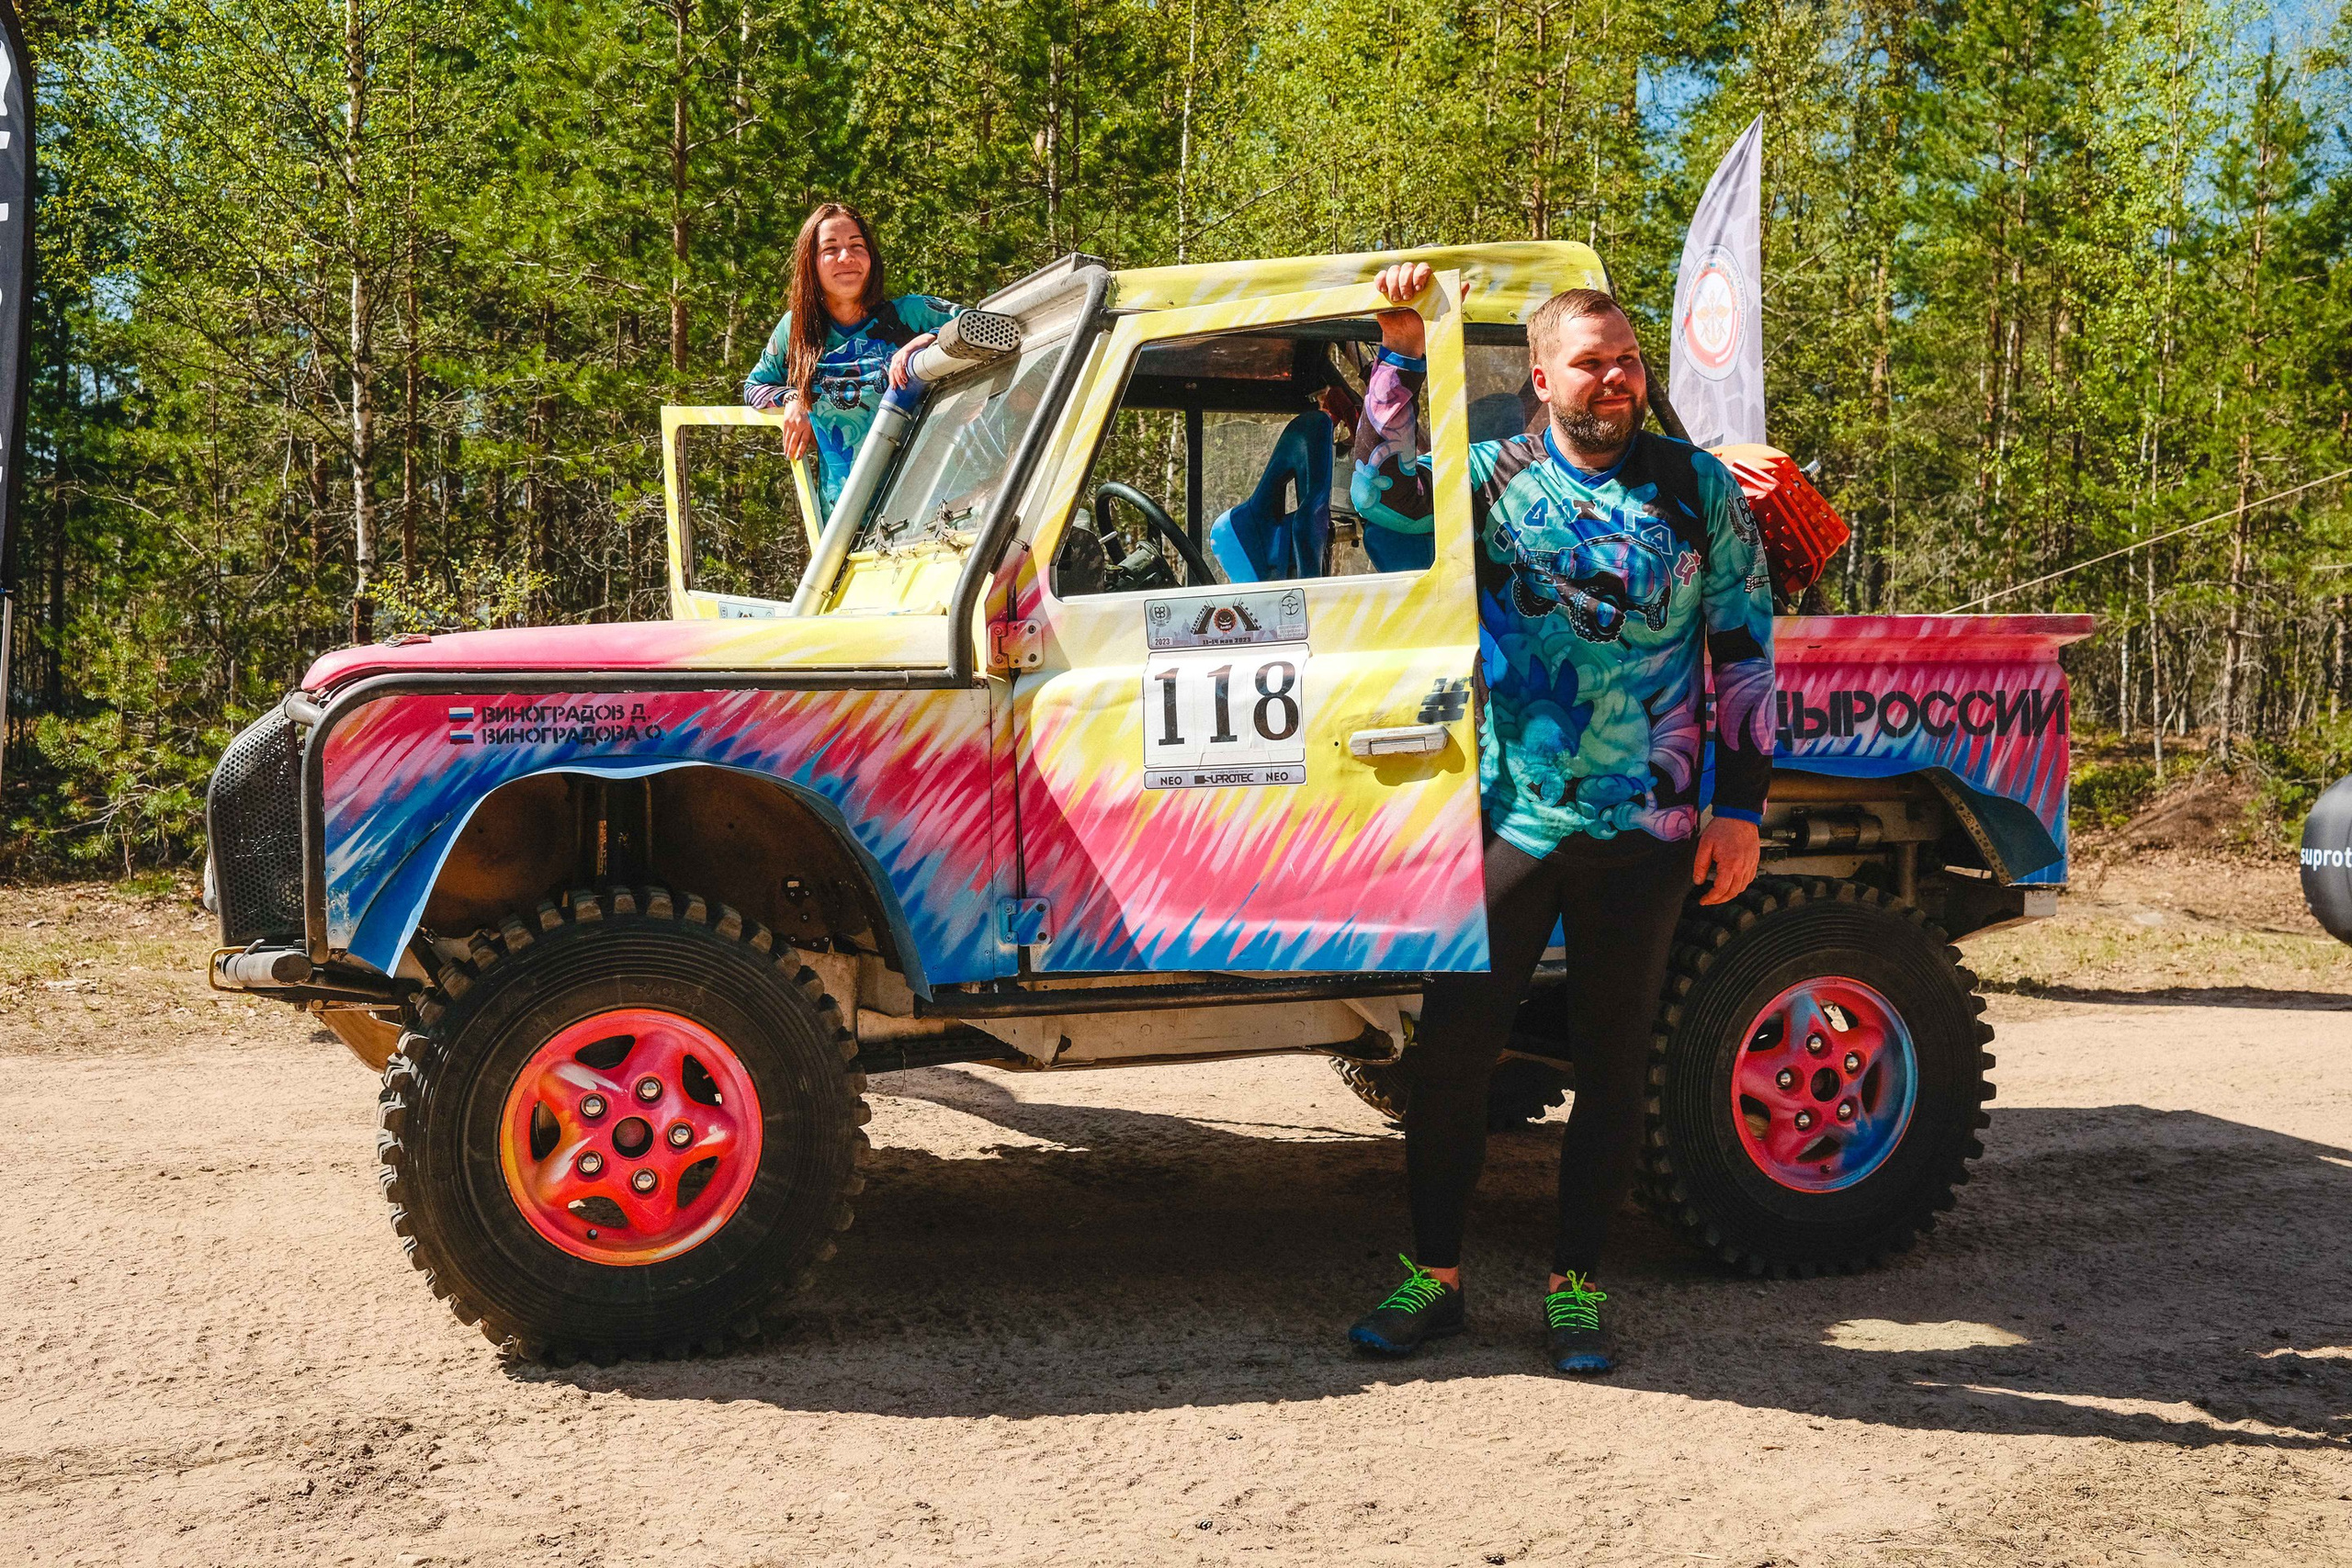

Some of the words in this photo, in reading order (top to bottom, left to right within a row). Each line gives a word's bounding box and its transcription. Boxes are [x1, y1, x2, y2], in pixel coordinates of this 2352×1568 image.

[1155, 637, 1170, 646] 2023
[1154, 660, 1299, 746] 118
[482, 705, 626, 724] ВИНОГРАДОВ
[631, 704, 651, 723] Д.
[1777, 689, 2066, 751] ЫРОССИИ
[482, 724, 639, 745] ВИНОГРАДОВА
[645, 723, 665, 741] О.
[1160, 776, 1182, 785] NEO
[1266, 772, 1289, 782] NEO
